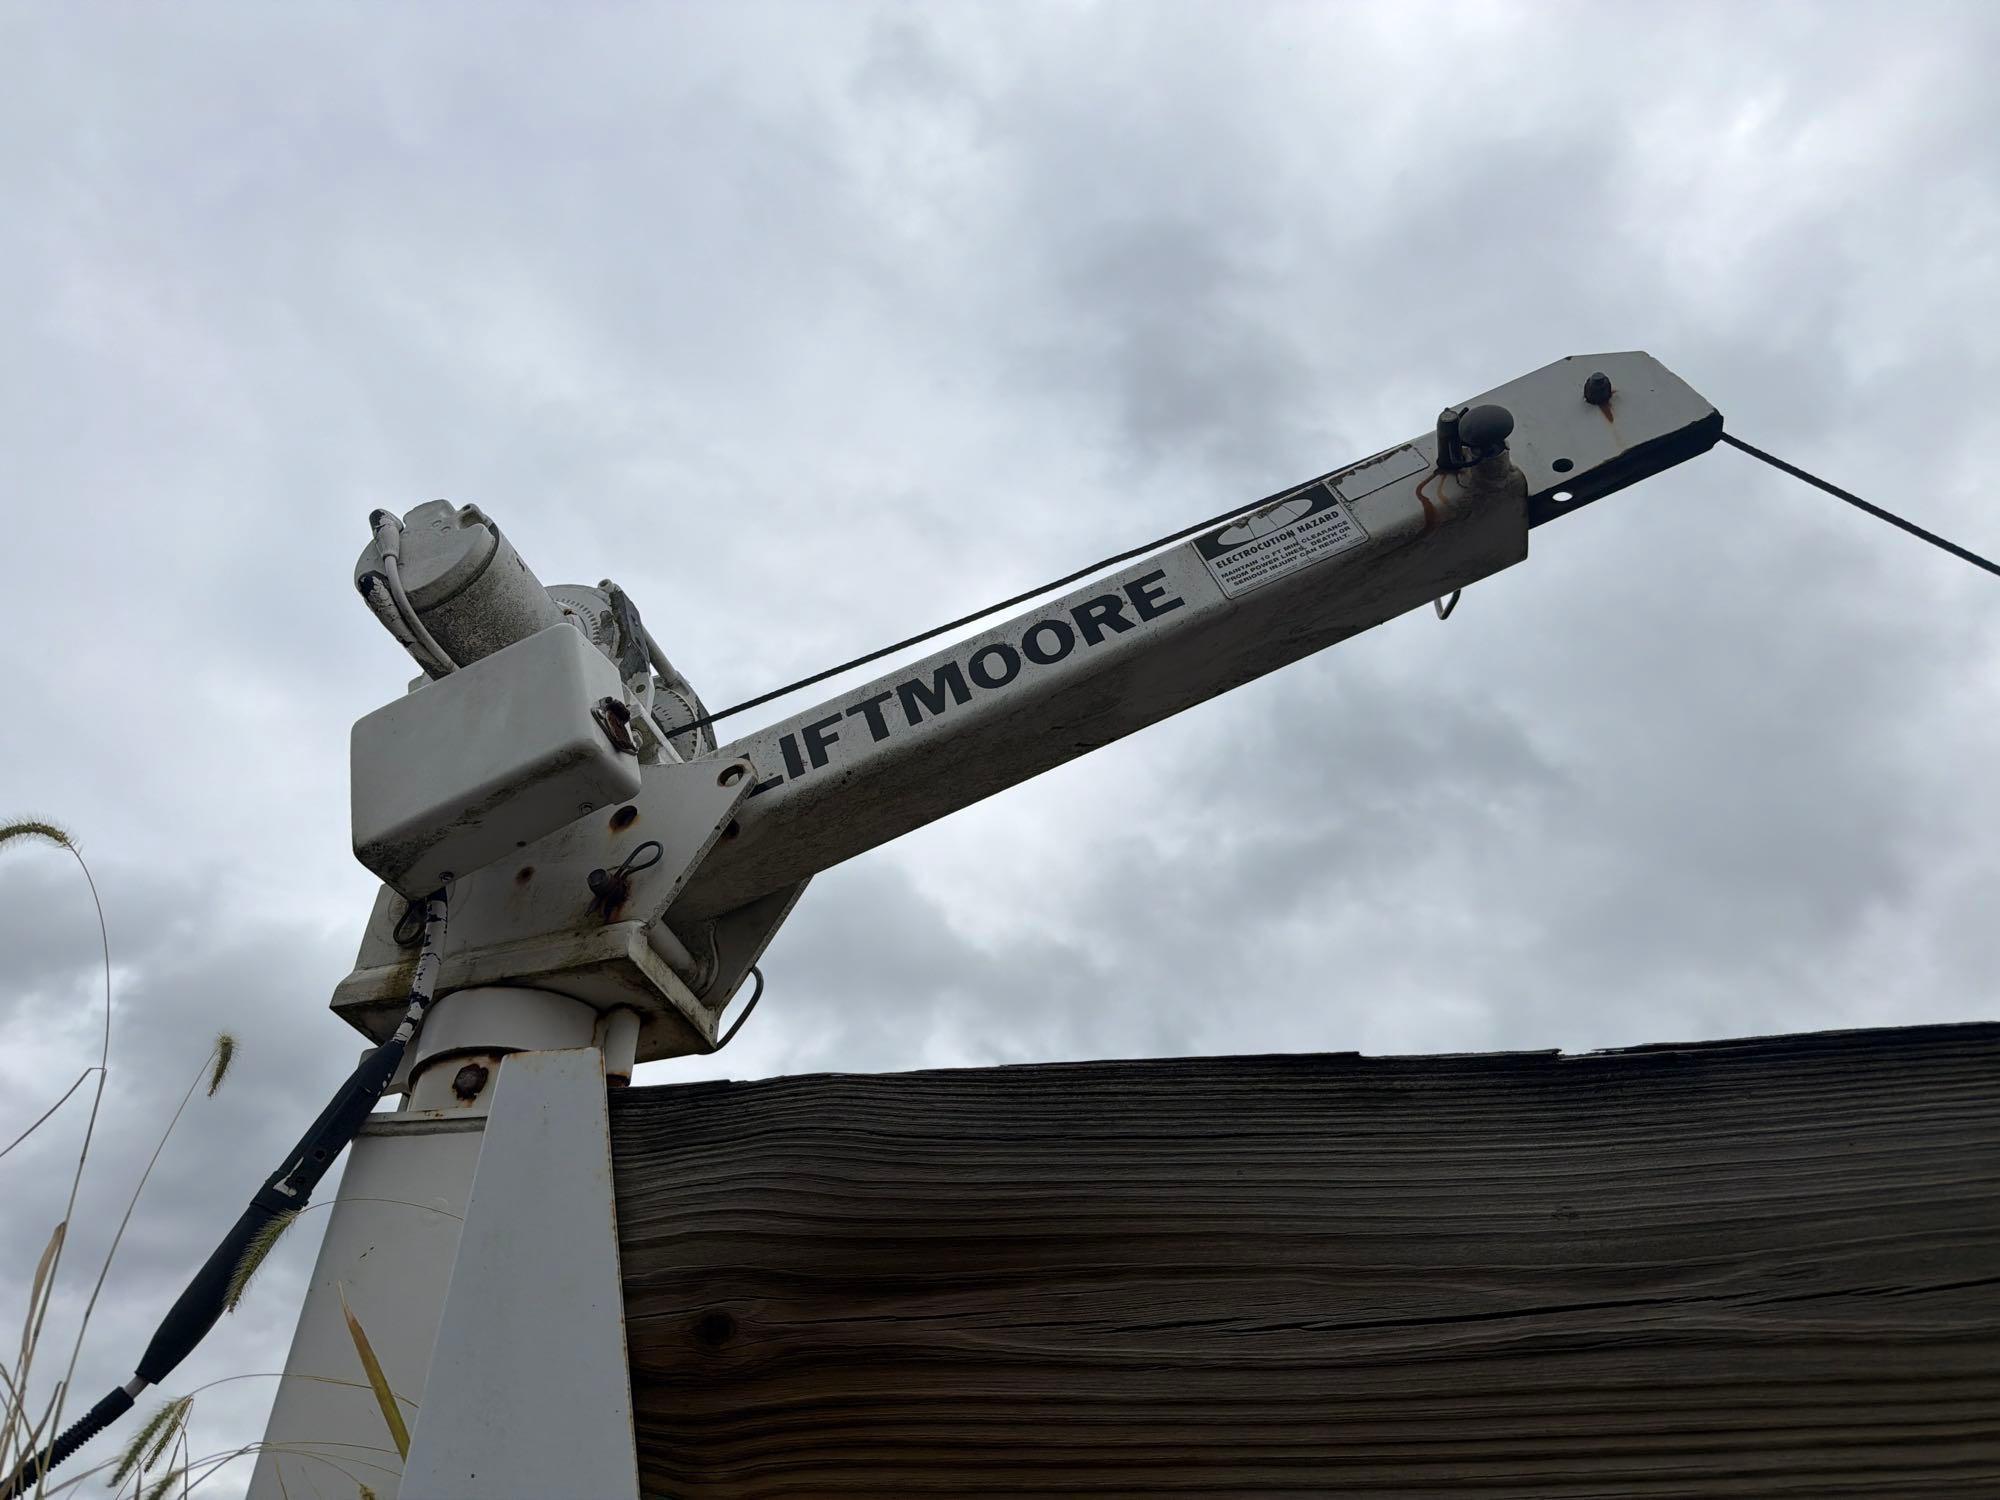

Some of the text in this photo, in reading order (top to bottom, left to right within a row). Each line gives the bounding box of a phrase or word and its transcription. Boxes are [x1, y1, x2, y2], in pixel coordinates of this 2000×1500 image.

[1215, 529, 1296, 569] ELECTROCUTION
[1297, 511, 1340, 533] HAZARD
[1221, 560, 1259, 579] MAINTAIN
[1260, 554, 1271, 562] 10
[1271, 548, 1282, 557] FT
[1301, 520, 1348, 544] CLEARANCE
[1225, 570, 1249, 583] FROM
[1250, 557, 1279, 573] POWER
[1311, 531, 1338, 546] DEATH
[1339, 525, 1351, 534] OR
[1233, 568, 1268, 586] SERIOUS
[1269, 555, 1297, 572] INJURY
[1300, 547, 1317, 557] CAN
